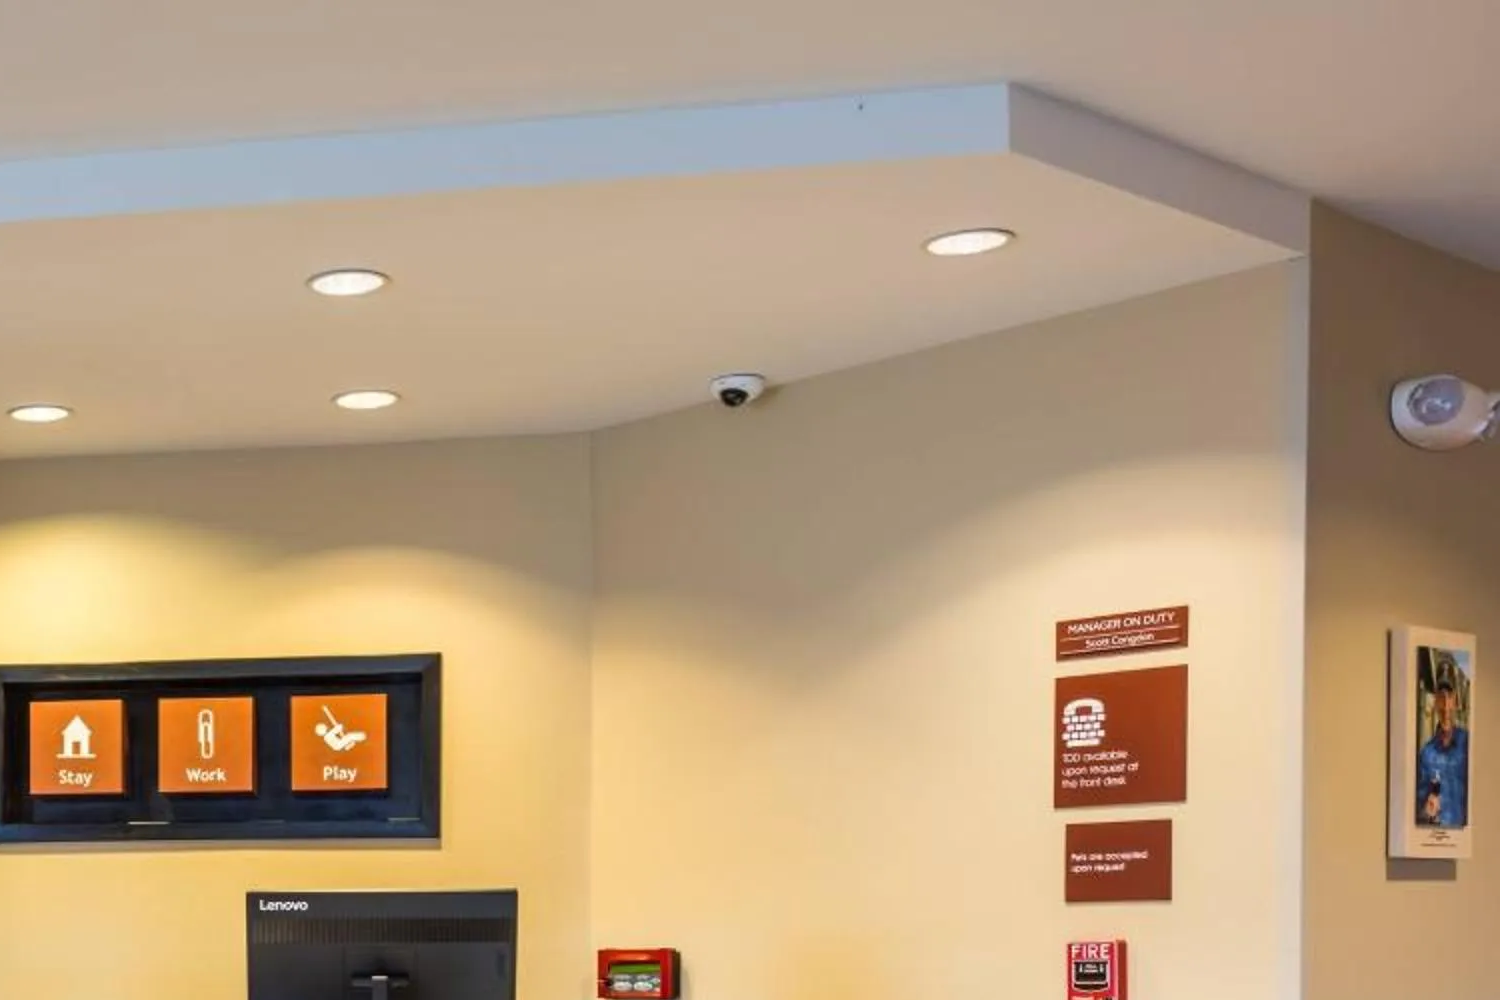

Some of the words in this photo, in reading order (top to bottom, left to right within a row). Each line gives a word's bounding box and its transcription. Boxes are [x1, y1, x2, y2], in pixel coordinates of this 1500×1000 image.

[1067, 619, 1120, 635] MANAGER
[1123, 615, 1141, 627] ON
[1143, 611, 1175, 625] DUTY
[185, 767, 227, 782] Work
[323, 765, 358, 783] Play
[1127, 762, 1139, 771] at
[59, 769, 93, 787] Stay
[259, 899, 309, 912] Lenovo
[1071, 943, 1109, 960] FIRE
